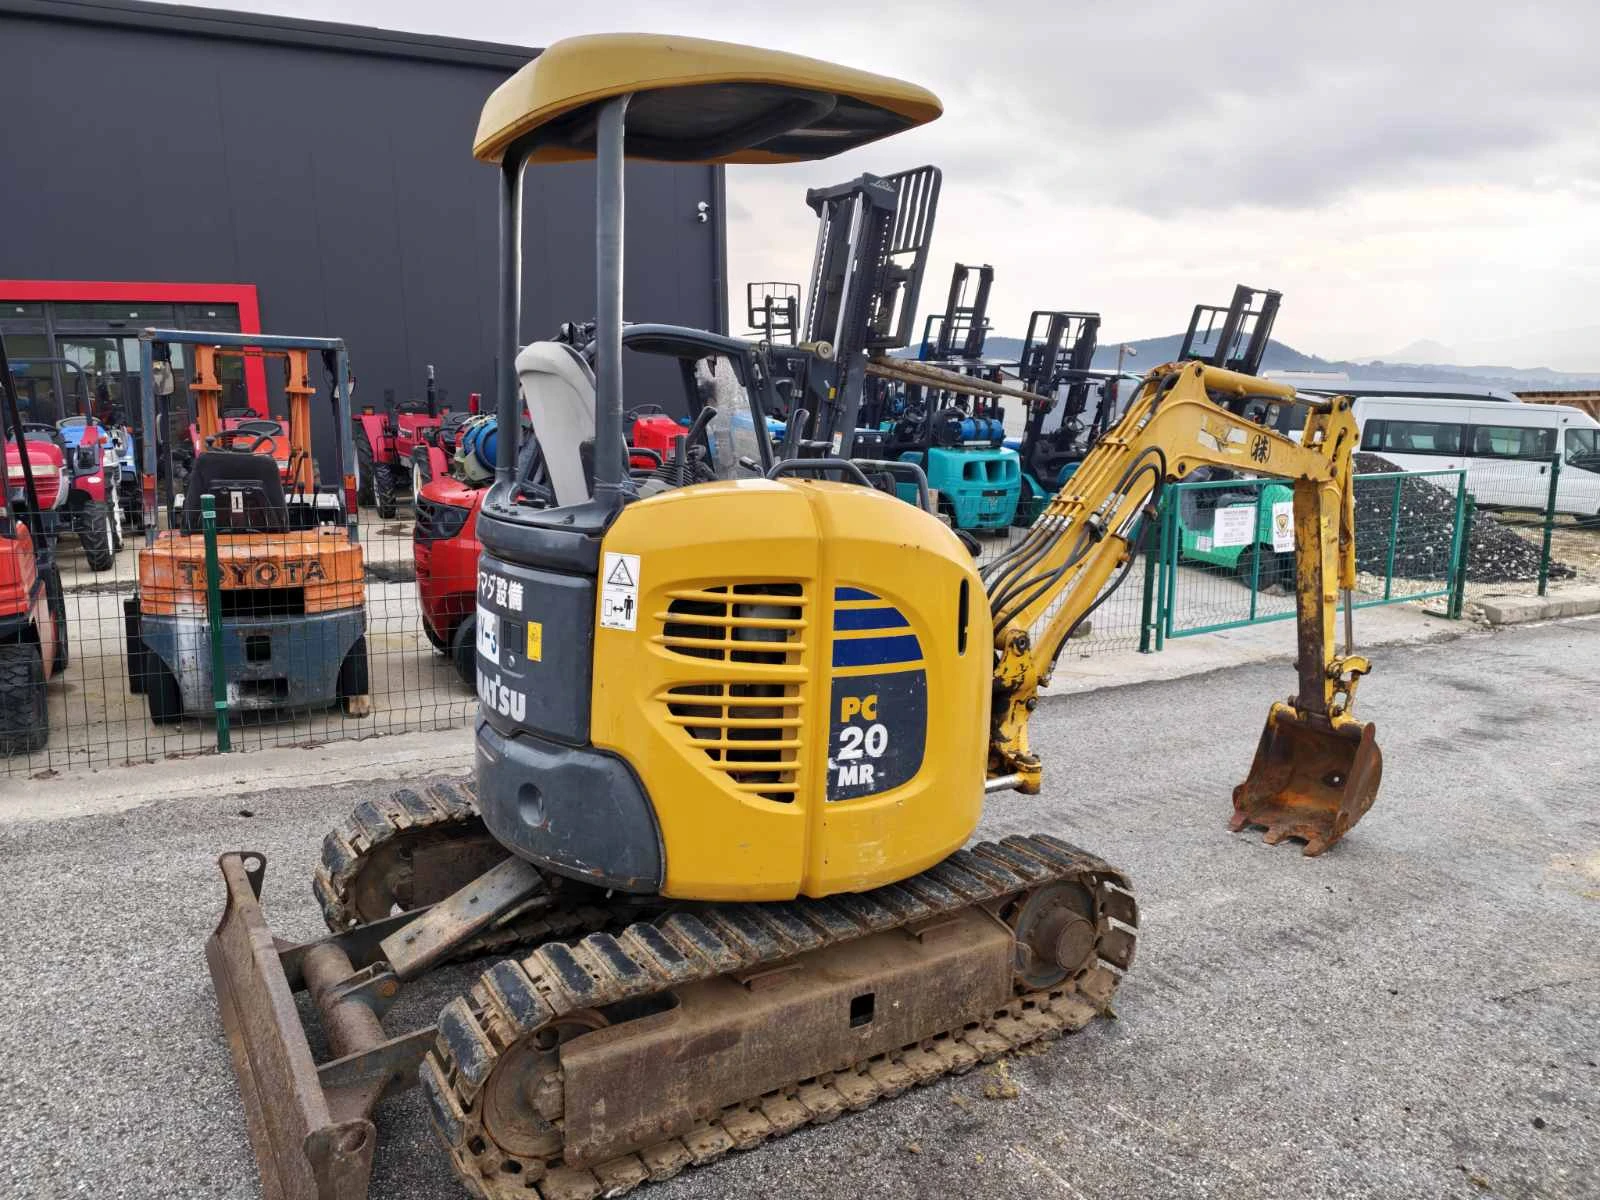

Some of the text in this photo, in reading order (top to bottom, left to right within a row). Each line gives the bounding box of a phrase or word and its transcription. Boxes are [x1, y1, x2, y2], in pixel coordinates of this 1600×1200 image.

[477, 570, 524, 612] マダ設備
[840, 694, 878, 723] PC
[837, 723, 889, 761] 20
